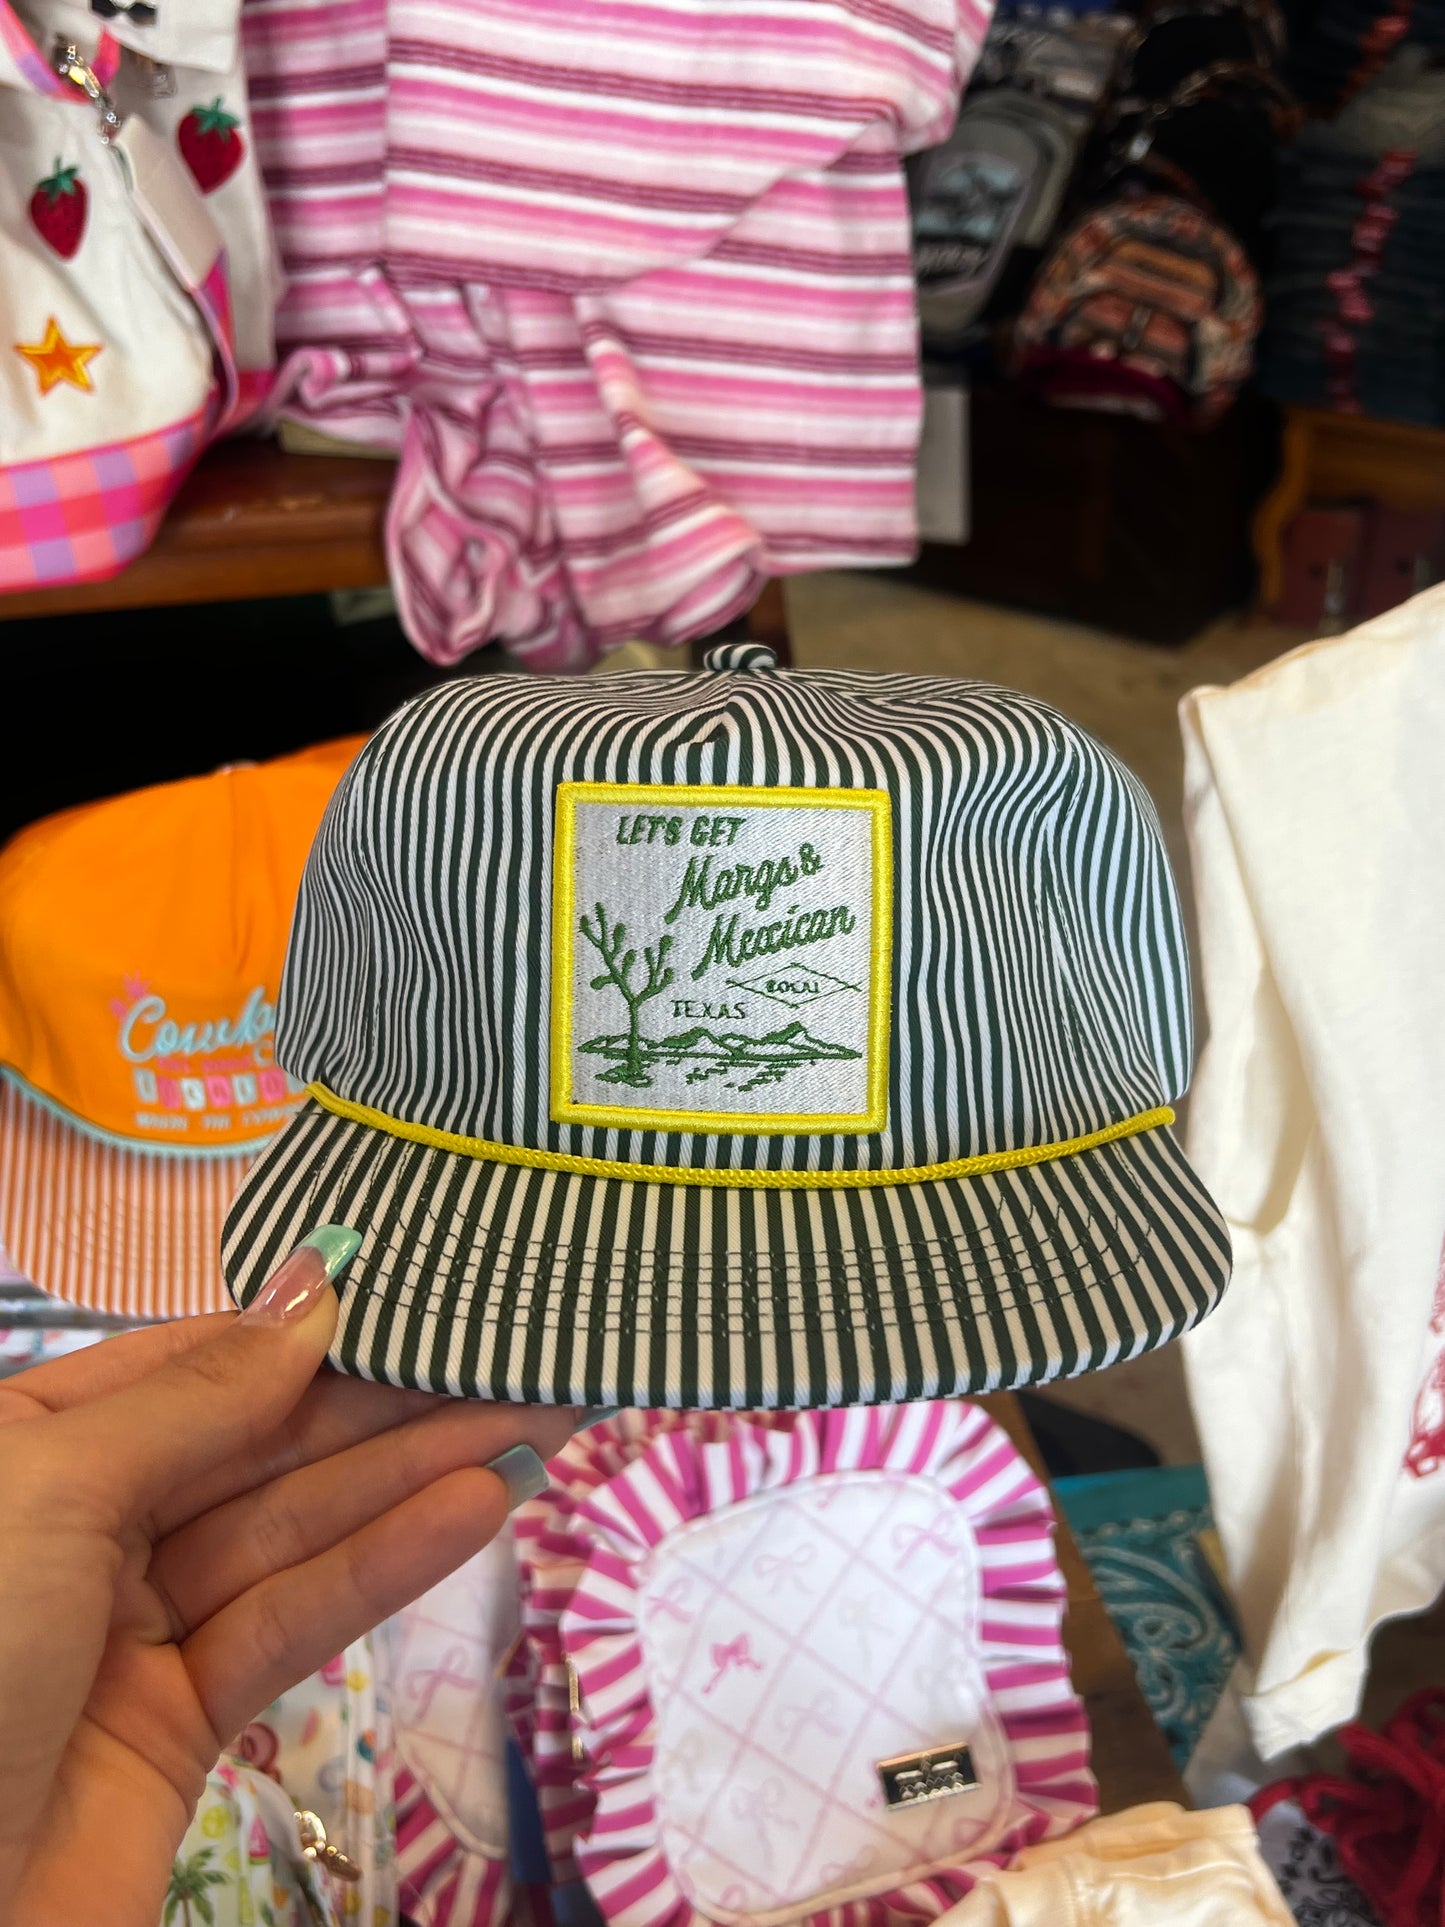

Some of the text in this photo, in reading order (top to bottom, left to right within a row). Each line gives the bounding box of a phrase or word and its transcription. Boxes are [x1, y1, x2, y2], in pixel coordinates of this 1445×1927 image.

[616, 815, 746, 847] LET'S GET
[690, 905, 856, 981] Mexican
[671, 999, 746, 1019] TEXAS
